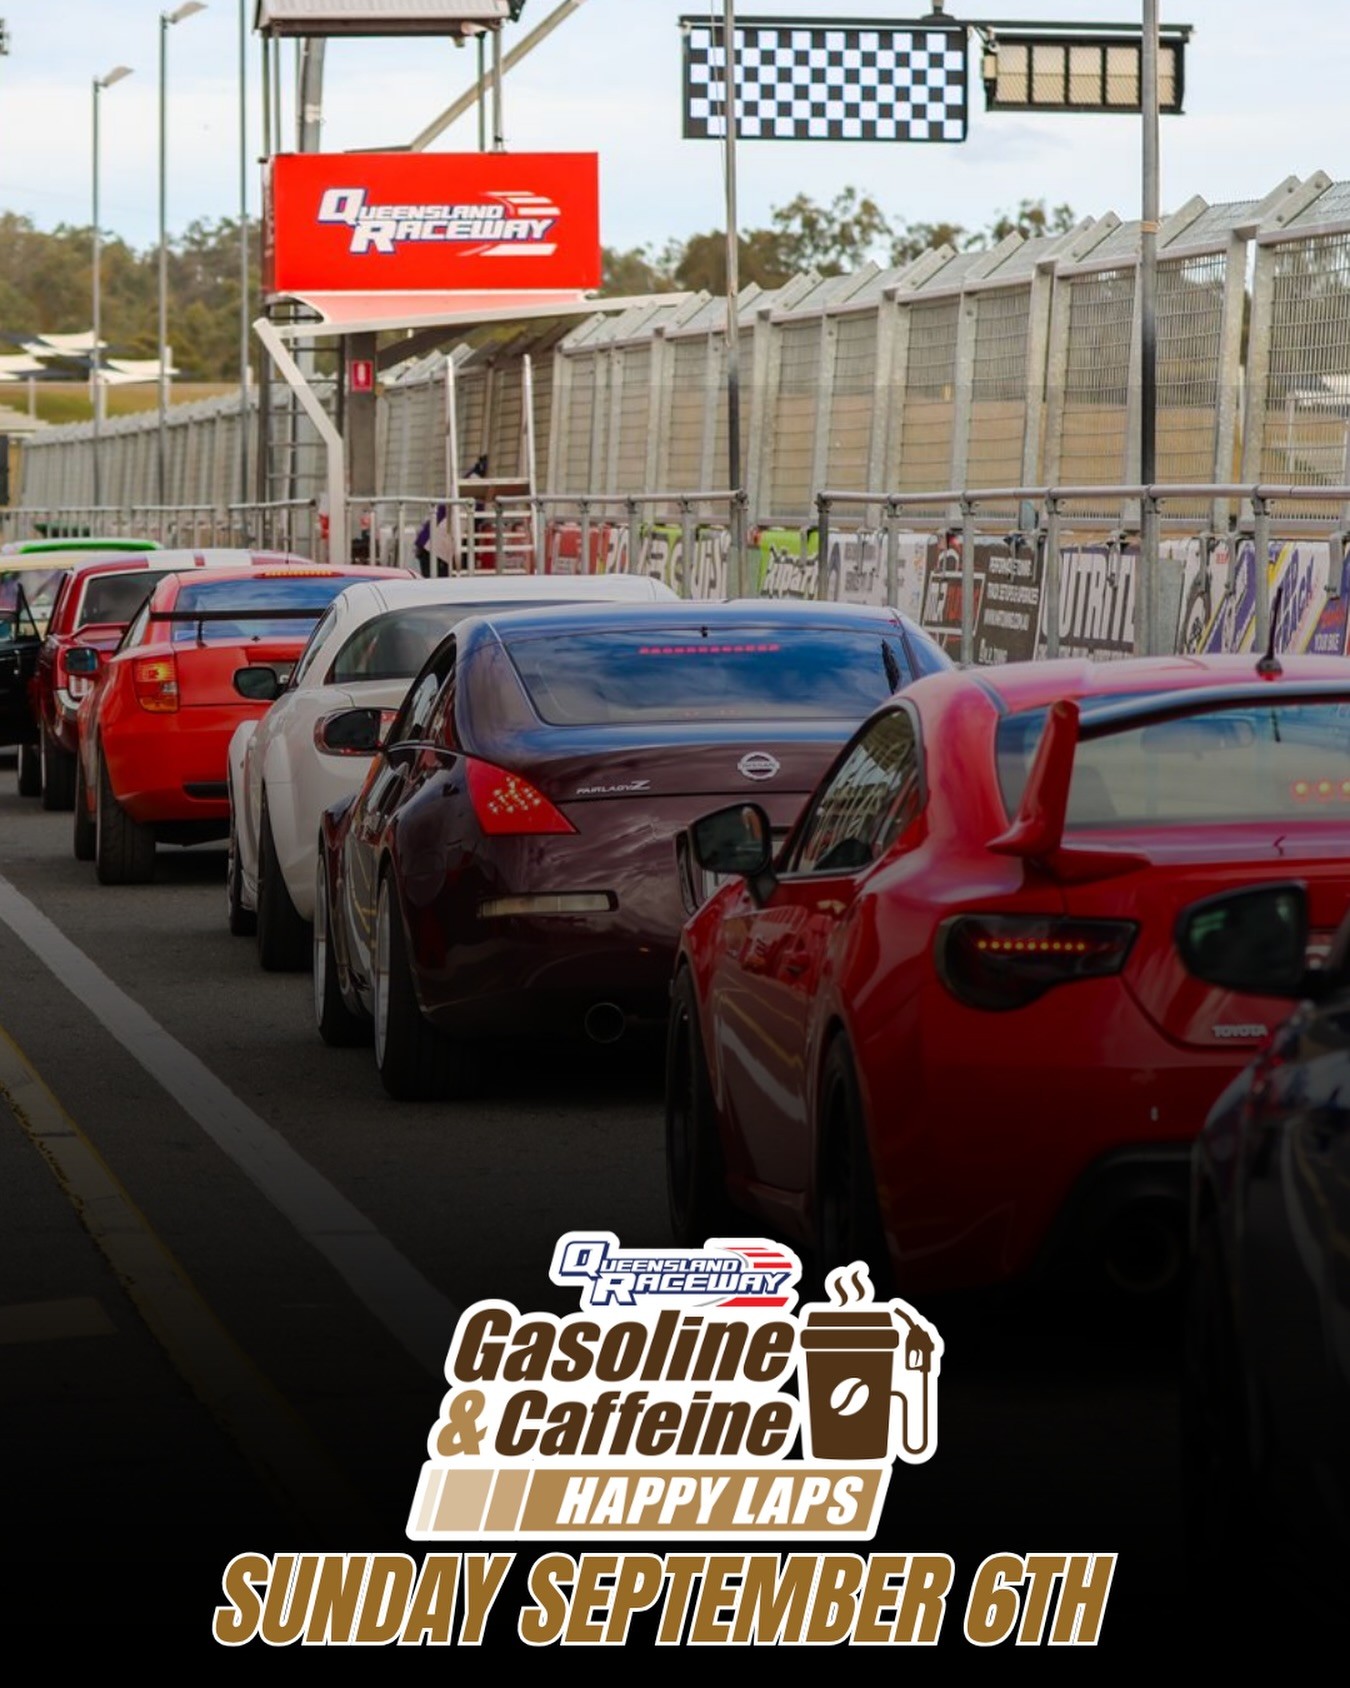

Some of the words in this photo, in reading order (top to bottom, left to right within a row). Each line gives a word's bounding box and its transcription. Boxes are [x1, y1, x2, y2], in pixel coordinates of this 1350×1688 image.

[317, 187, 505, 227] QUEENSLAND
[349, 217, 555, 255] RACEWAY
[1213, 1025, 1267, 1037] TOYOTA
